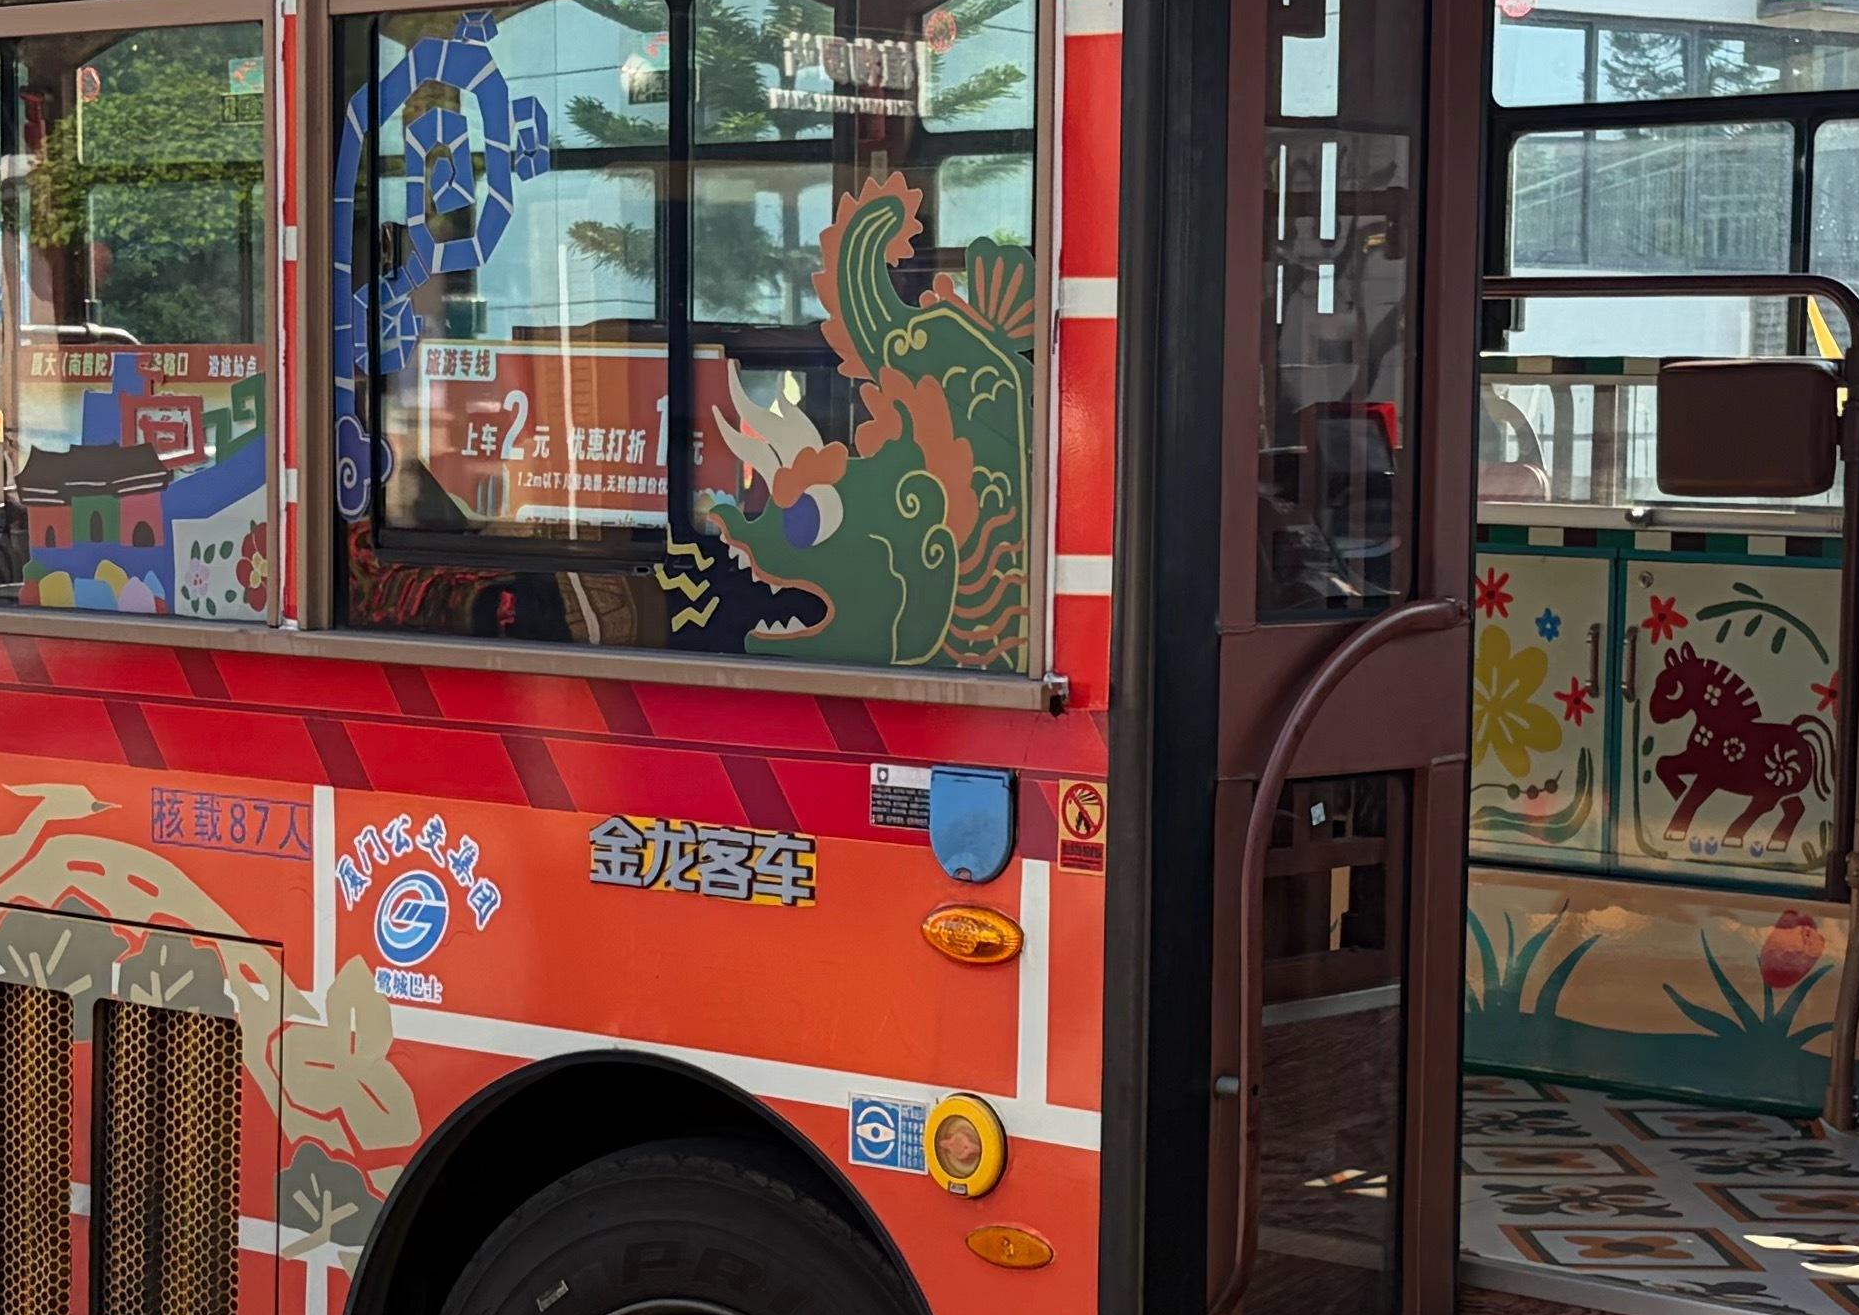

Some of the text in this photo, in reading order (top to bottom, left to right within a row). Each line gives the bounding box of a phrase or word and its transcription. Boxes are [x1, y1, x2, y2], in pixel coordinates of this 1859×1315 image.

[425, 347, 492, 377] 旅游专线
[154, 790, 312, 854] 核载87人
[335, 813, 502, 931] 厦门公交集团
[589, 814, 816, 906] 金龙客车
[374, 966, 444, 1004] 鹭城巴士
